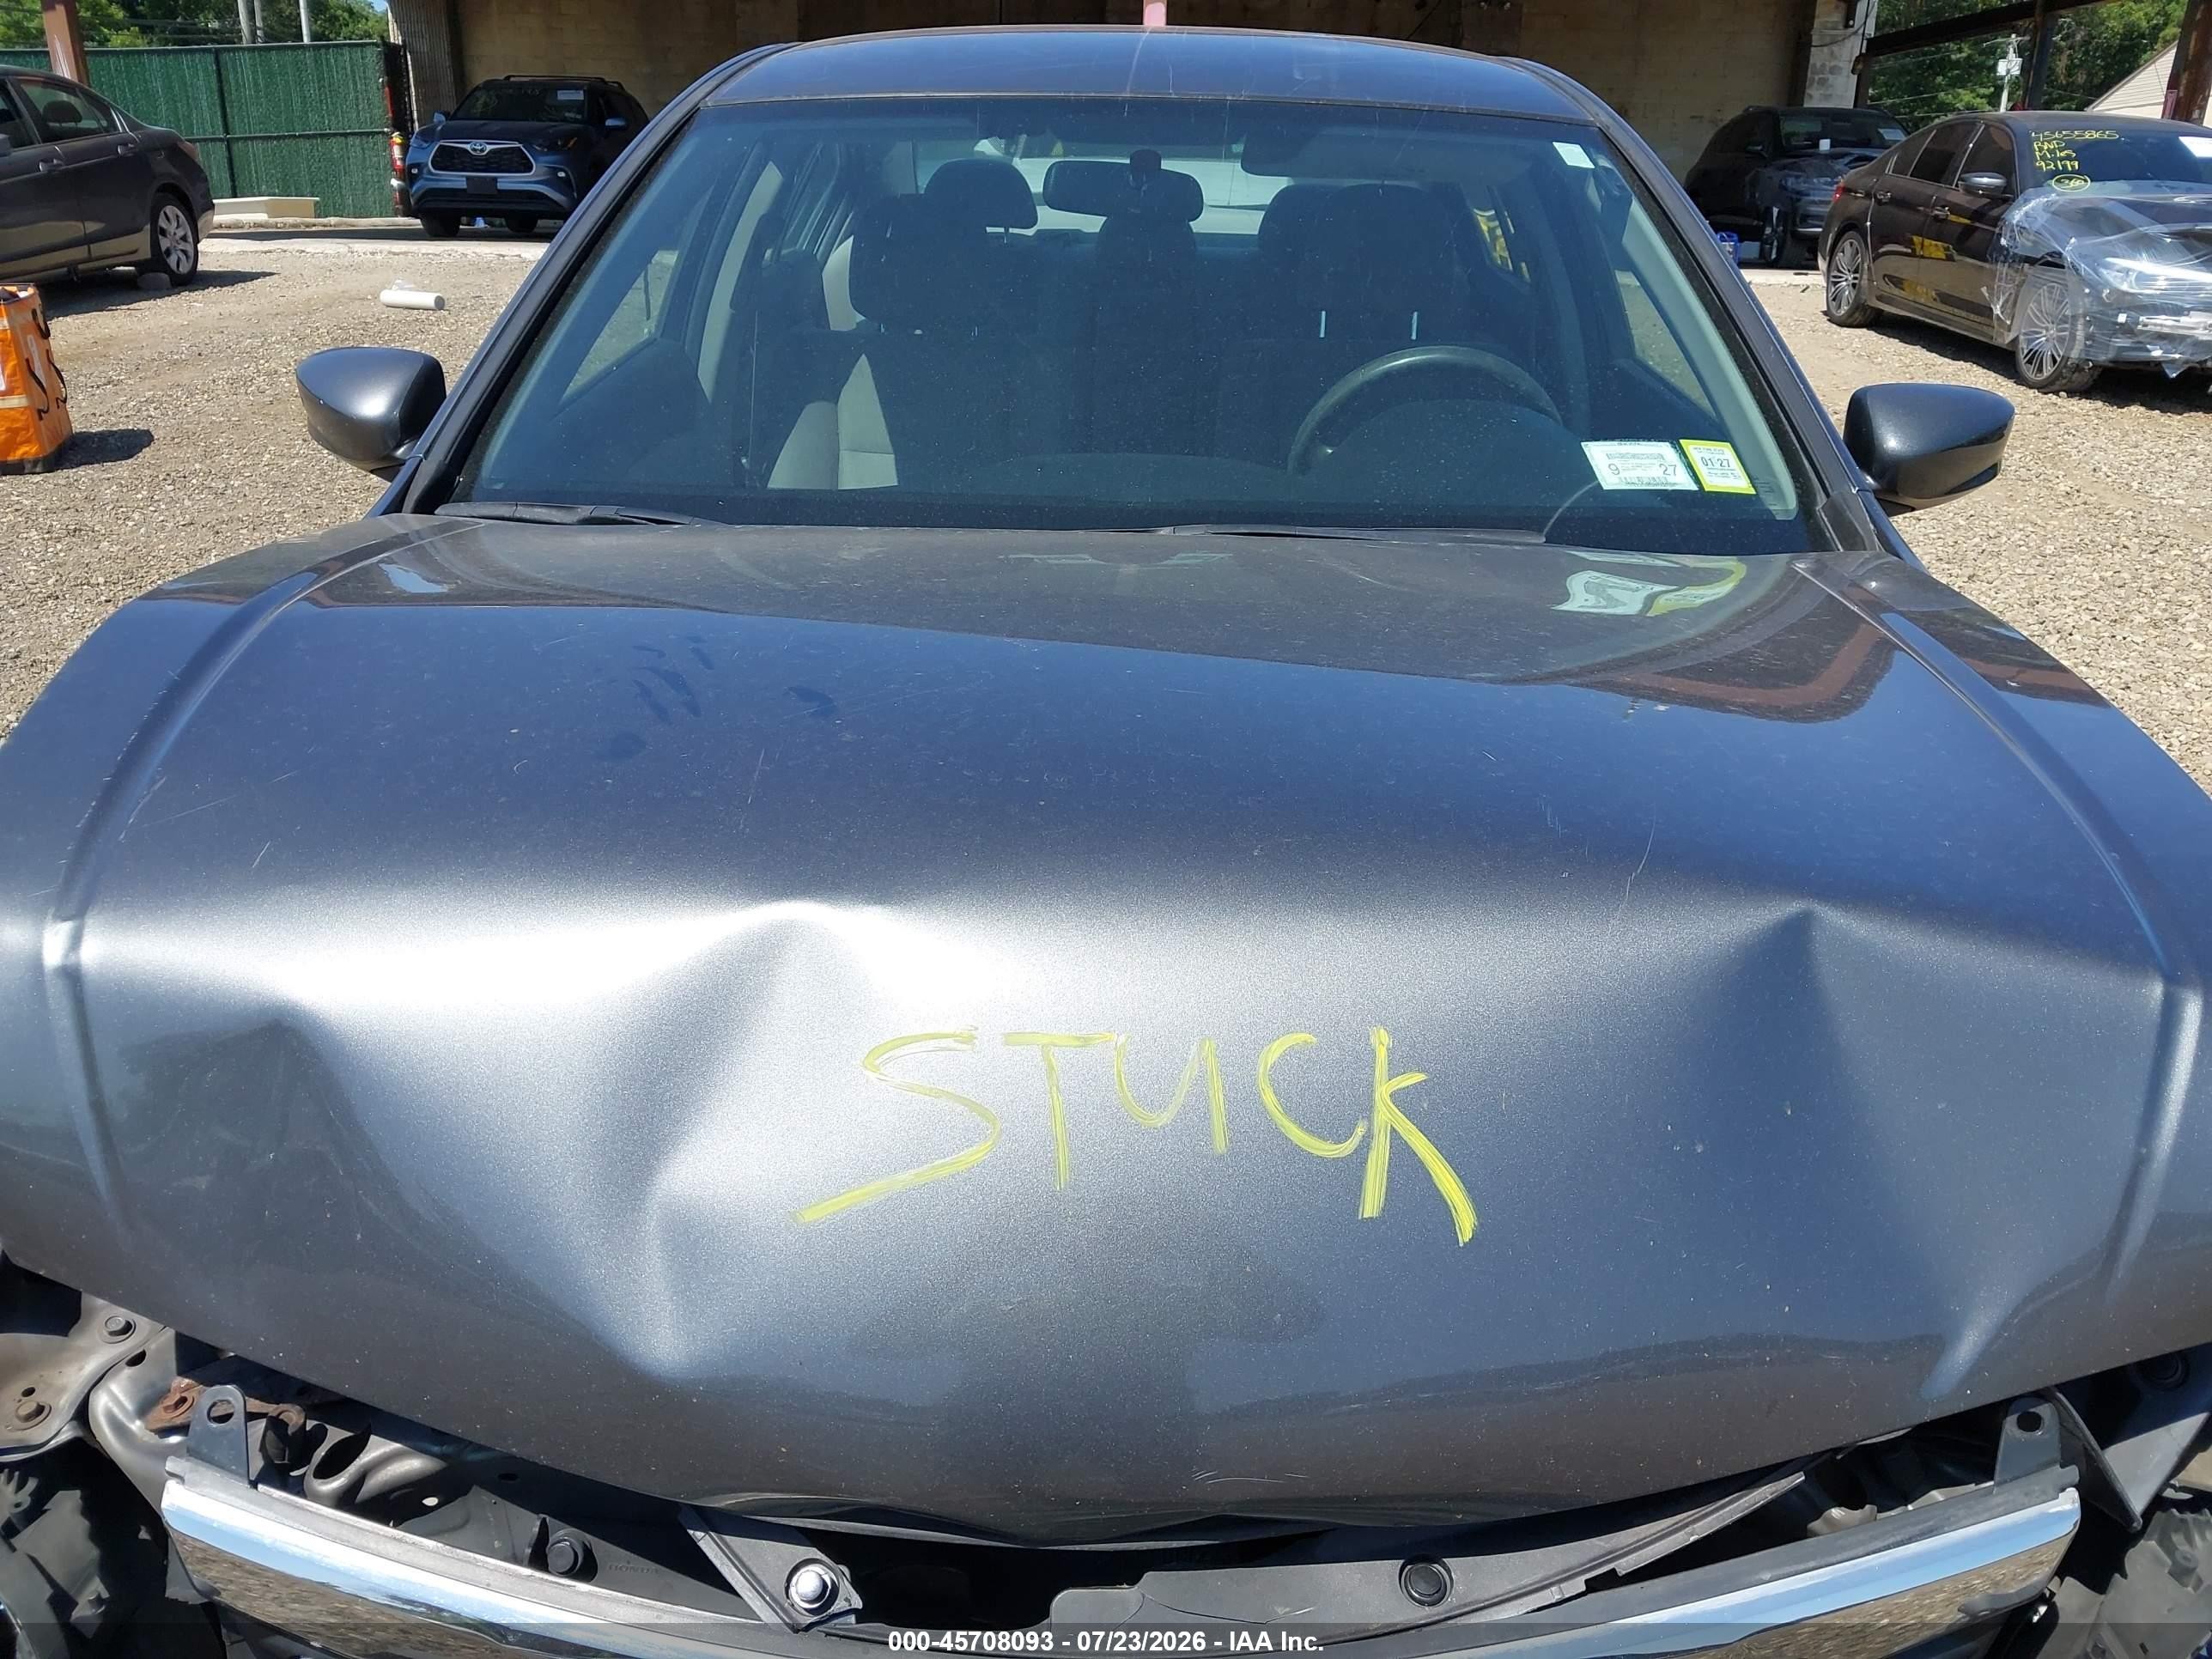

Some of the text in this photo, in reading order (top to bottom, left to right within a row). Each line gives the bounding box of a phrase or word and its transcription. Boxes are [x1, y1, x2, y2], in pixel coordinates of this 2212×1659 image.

[2036, 160, 2079, 172] 92199
[1700, 456, 1730, 468] 01 27
[1607, 463, 1620, 476] 9
[1658, 463, 1678, 477] 27
[792, 1024, 1479, 1247] STUCK
